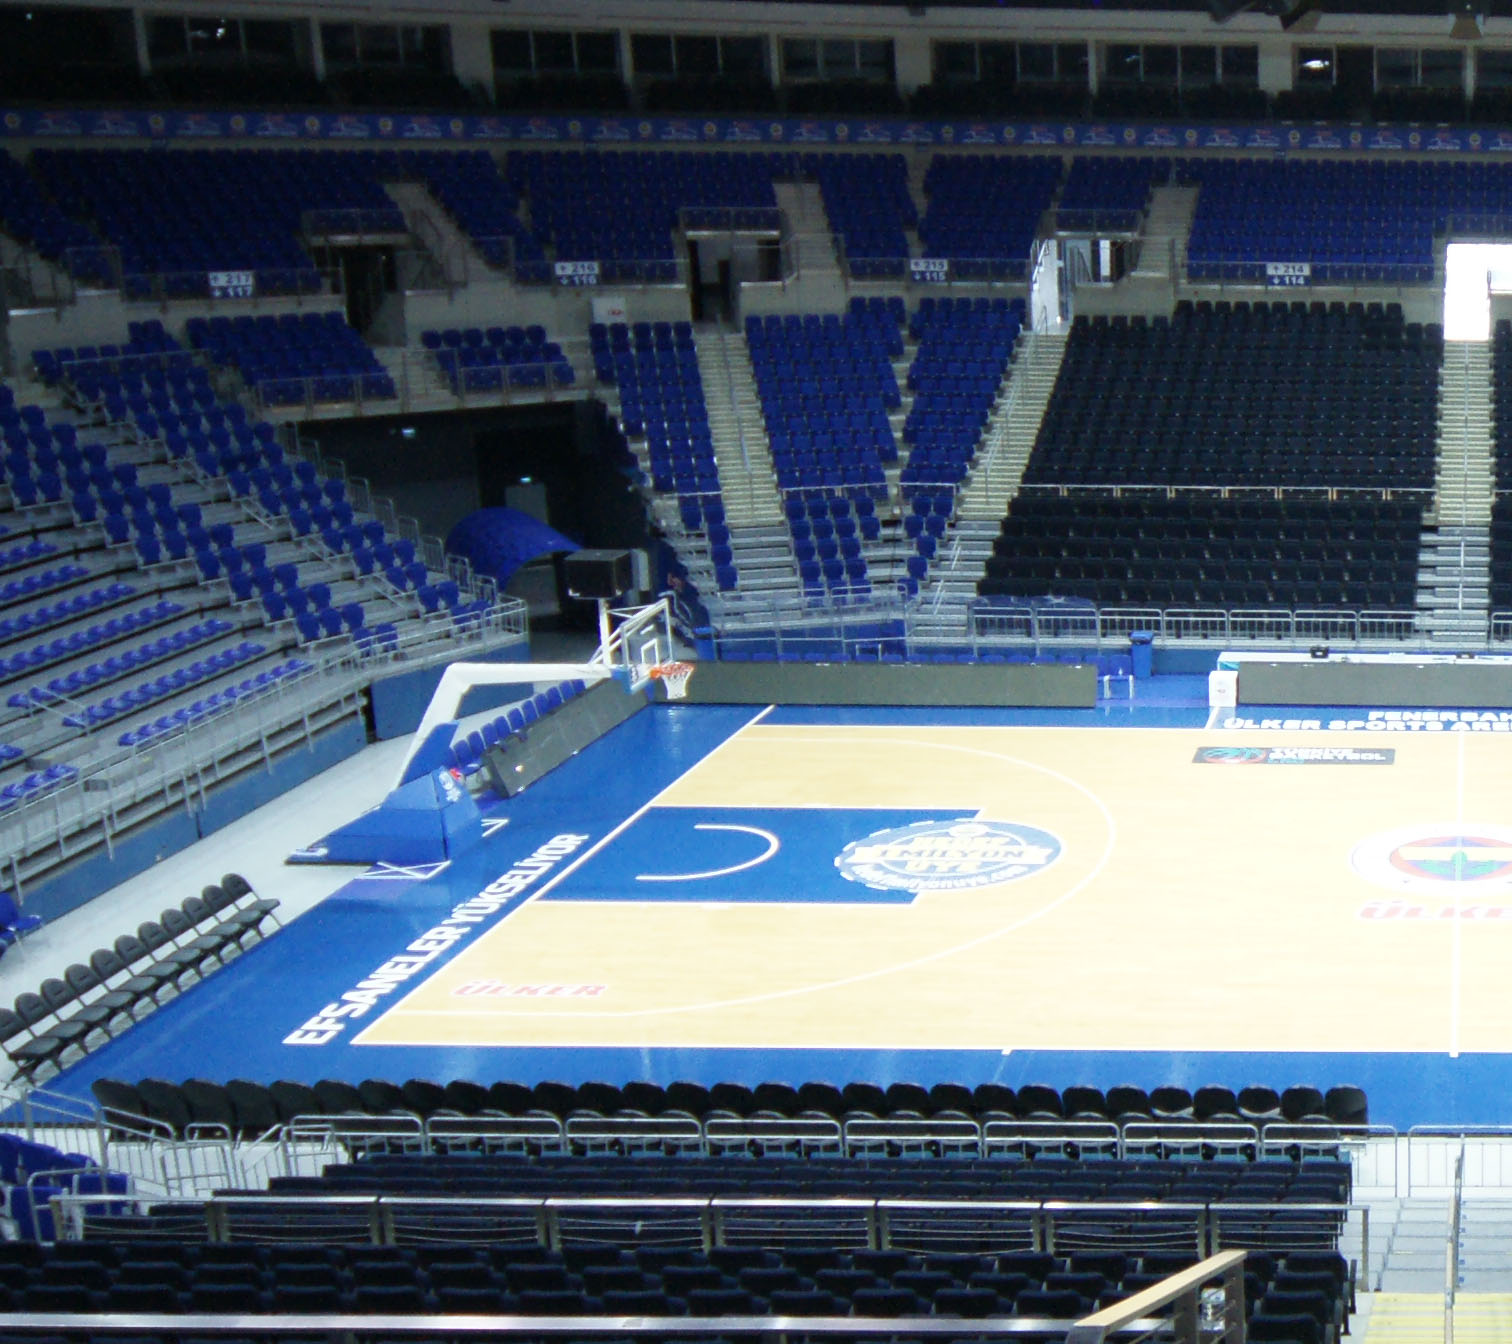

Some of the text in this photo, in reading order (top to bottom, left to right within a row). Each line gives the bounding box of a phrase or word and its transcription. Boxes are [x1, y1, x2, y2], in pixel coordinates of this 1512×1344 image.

[1282, 264, 1305, 274] 214
[925, 271, 947, 281] 115
[1283, 275, 1305, 285] 114
[1224, 718, 1322, 731] ÜLKER
[1328, 720, 1445, 732] SPORTS
[282, 833, 590, 1045] EFSANELER YÜKSELİYOR
[453, 979, 607, 996] ÜLKER
